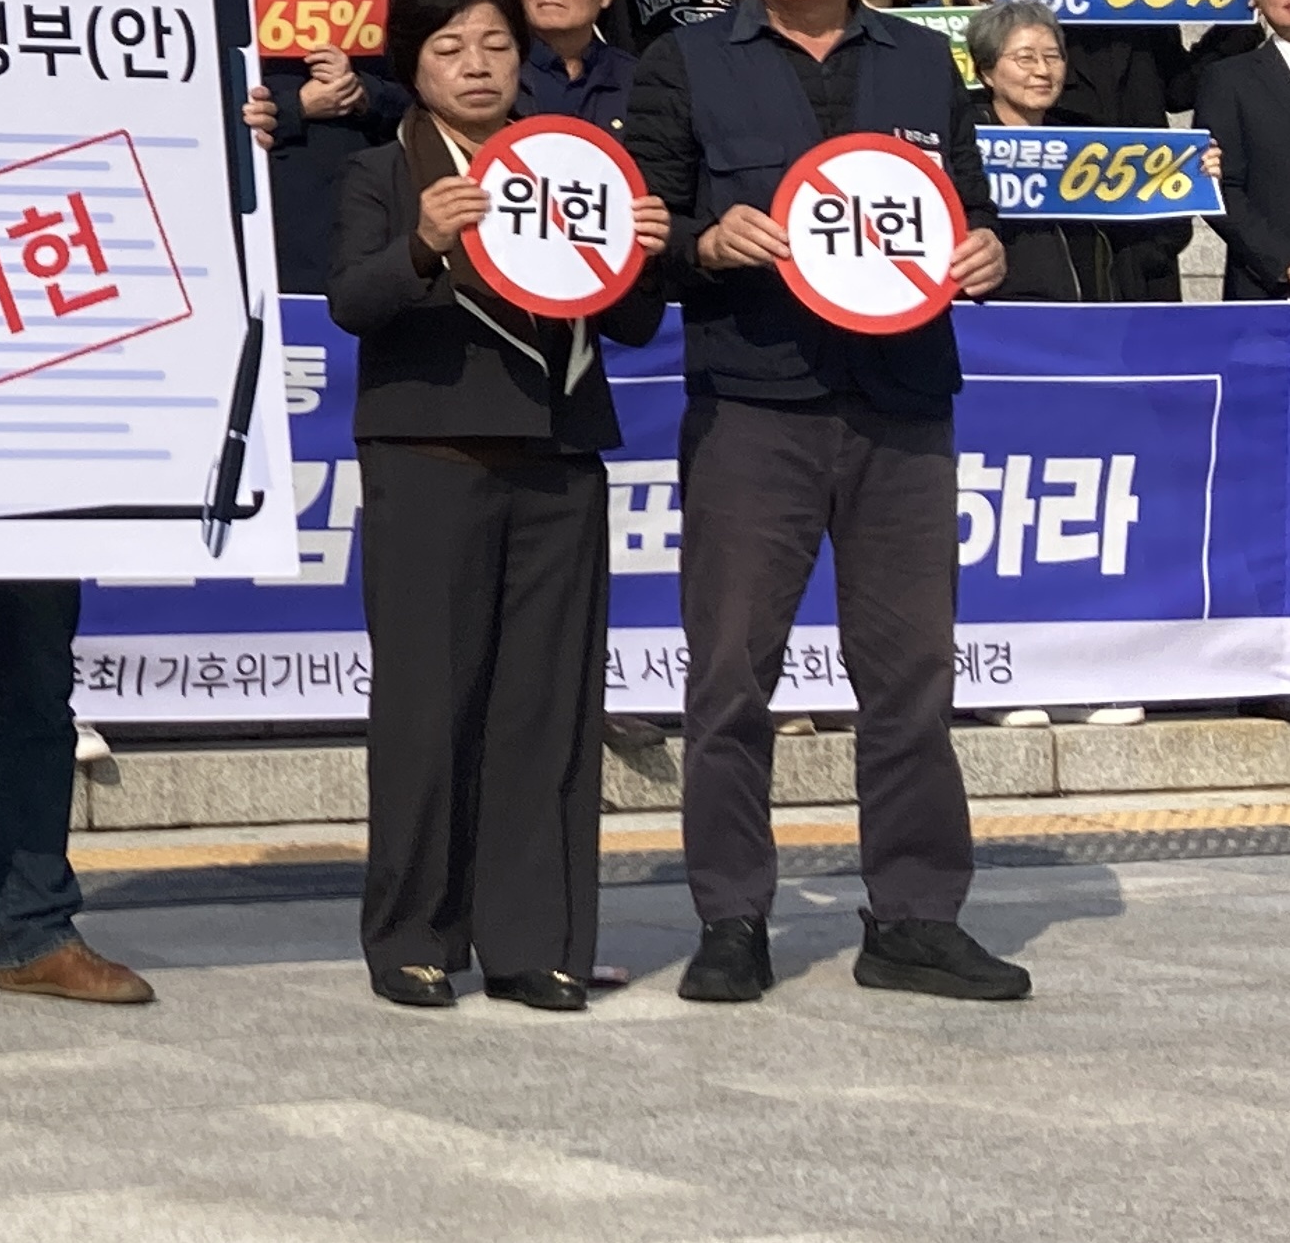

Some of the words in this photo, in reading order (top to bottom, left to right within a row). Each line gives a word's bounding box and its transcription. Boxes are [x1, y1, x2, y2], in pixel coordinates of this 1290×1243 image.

[258, 0, 382, 50] 65%
[1058, 142, 1197, 202] 65%
[498, 176, 609, 245] 위헌
[810, 196, 926, 257] 위헌
